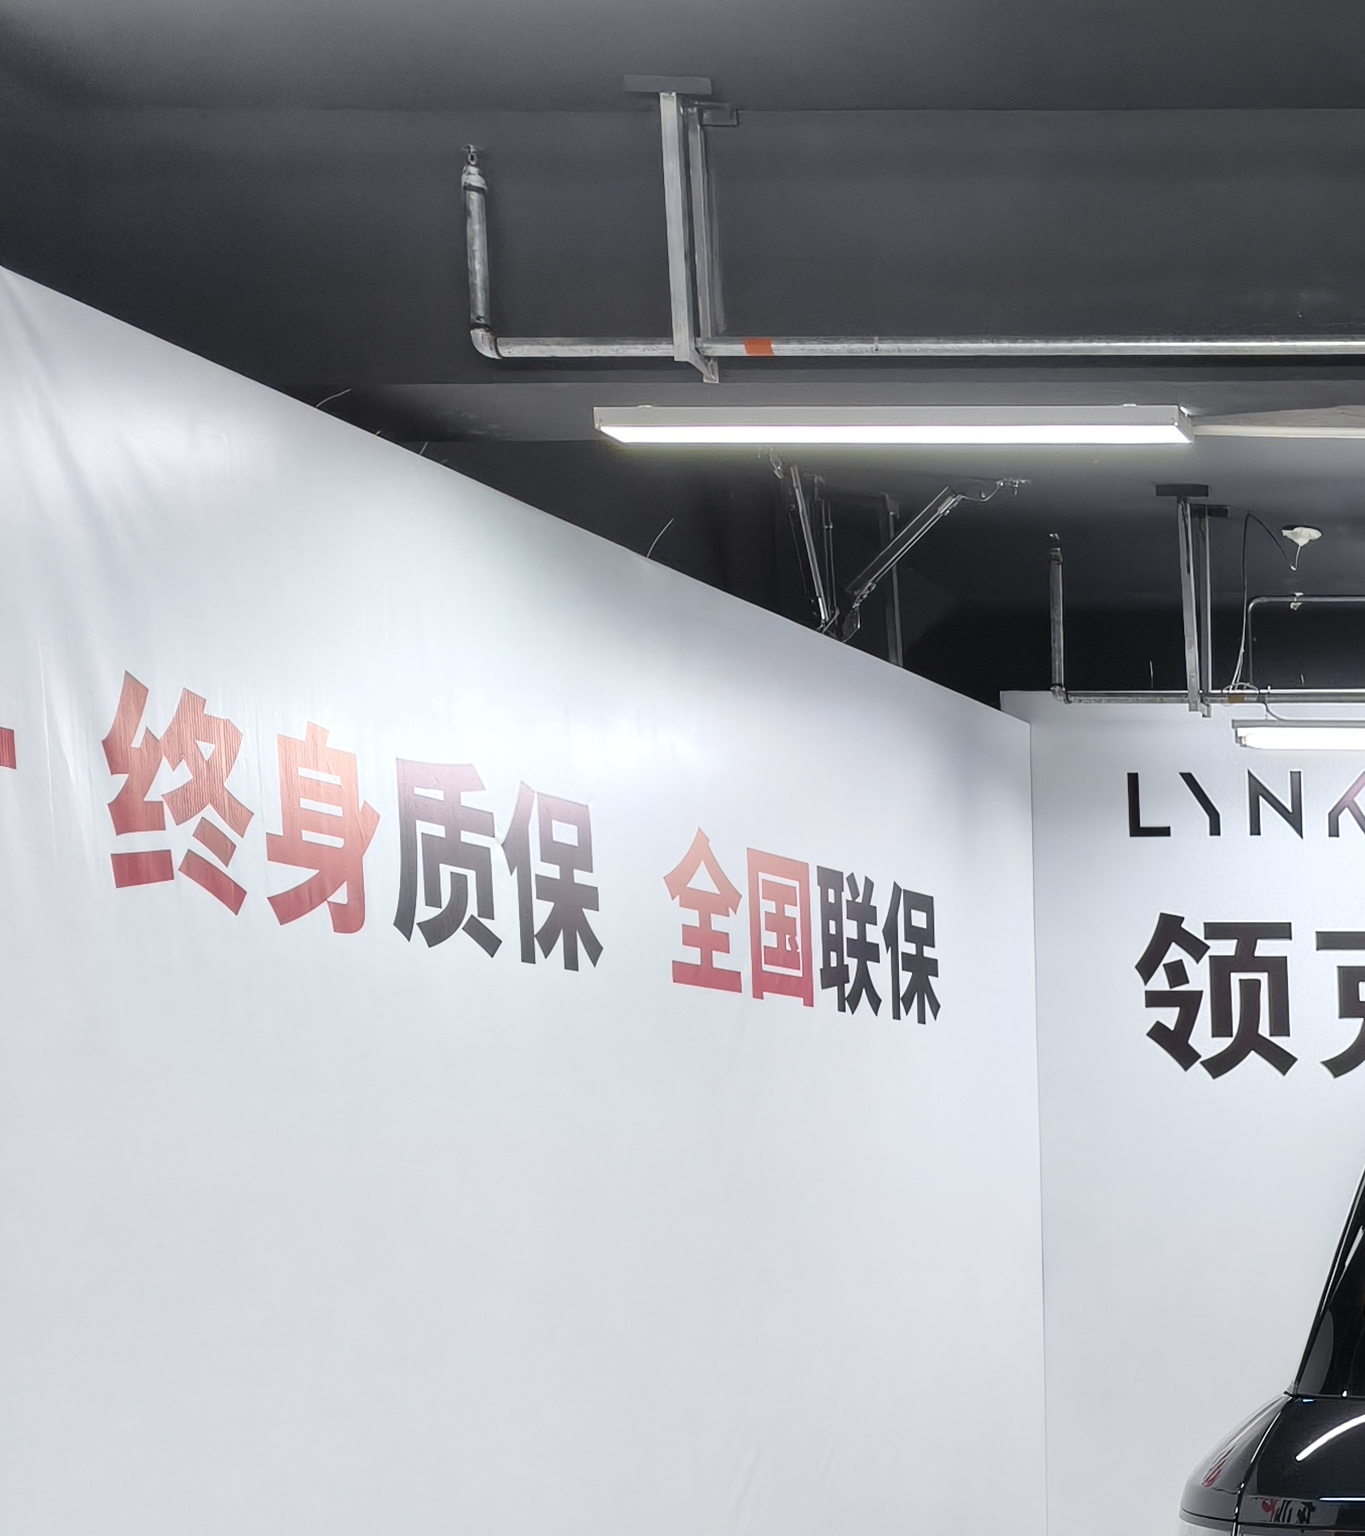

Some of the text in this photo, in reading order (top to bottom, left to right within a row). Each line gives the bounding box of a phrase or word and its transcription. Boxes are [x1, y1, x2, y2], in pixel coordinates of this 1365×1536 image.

[101, 670, 943, 1026] 终身质保 全国联保
